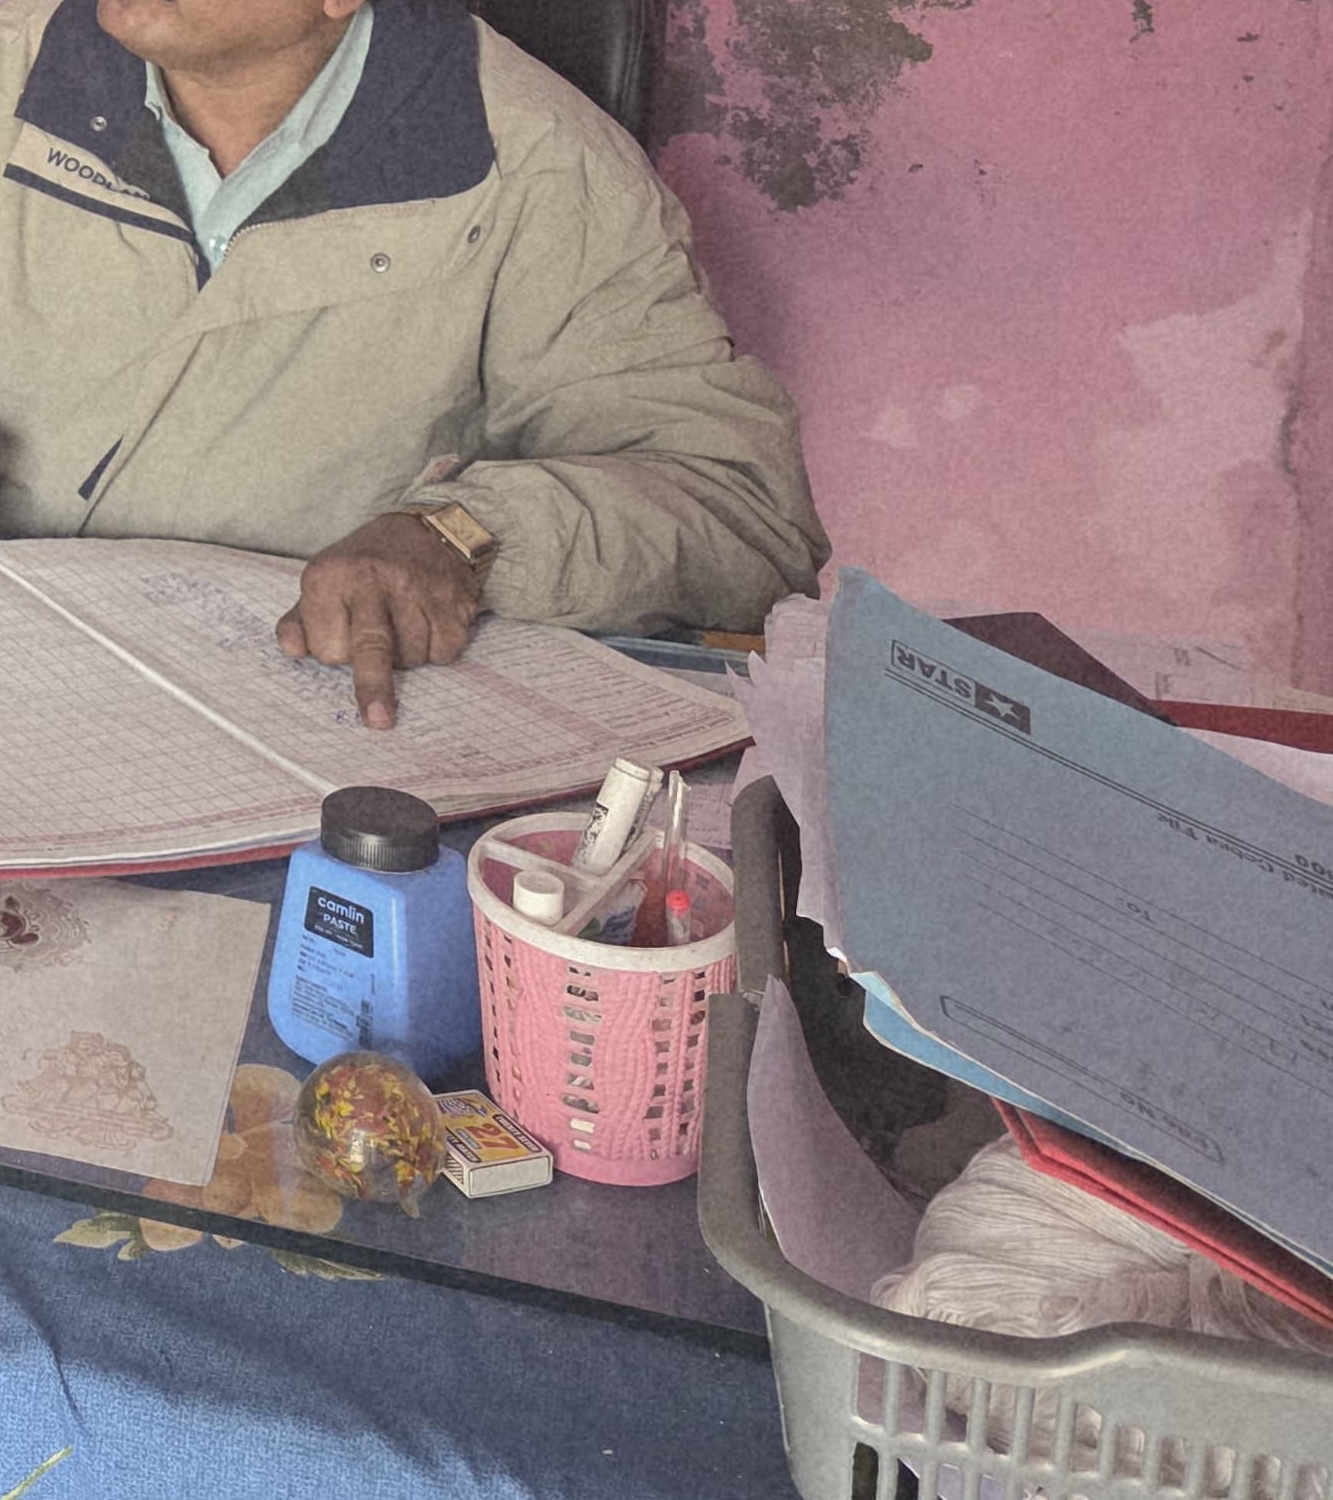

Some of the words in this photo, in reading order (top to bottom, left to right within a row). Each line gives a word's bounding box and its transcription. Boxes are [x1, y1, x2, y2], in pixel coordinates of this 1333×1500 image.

[47, 147, 151, 200] WOODL
[897, 646, 972, 699] STAR
[317, 897, 365, 925] camlin
[323, 915, 357, 935] PASTE
[465, 1122, 520, 1150] 27
